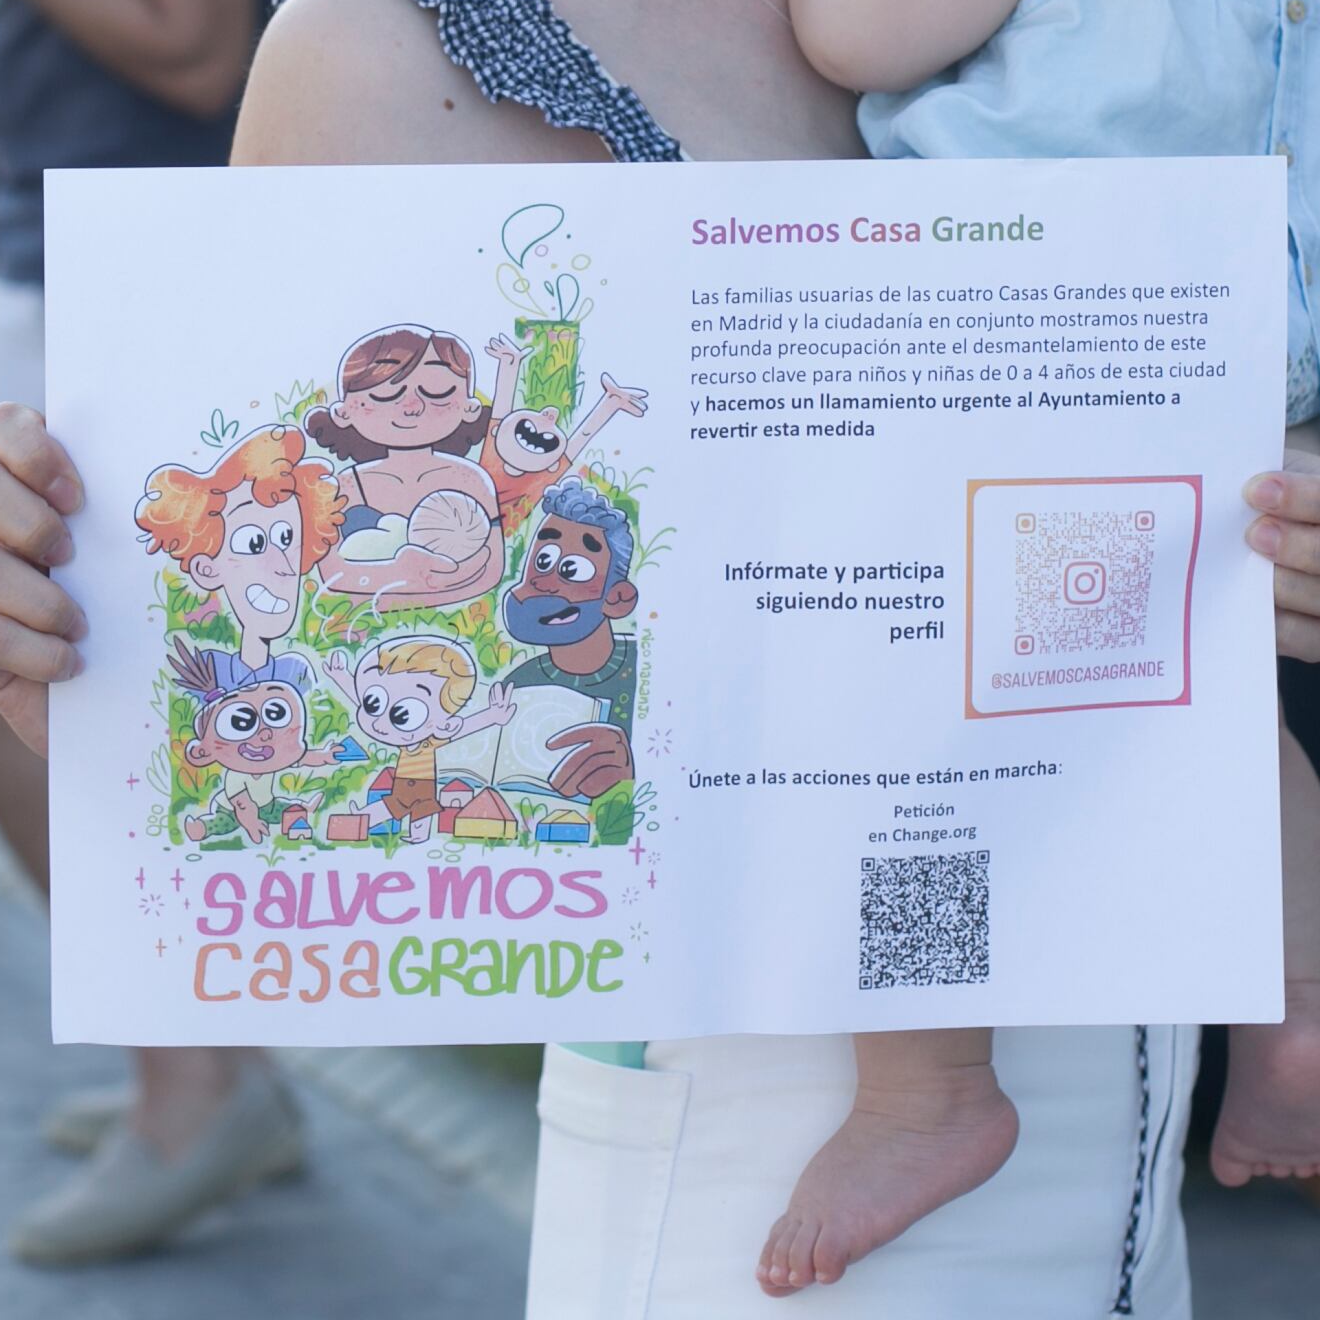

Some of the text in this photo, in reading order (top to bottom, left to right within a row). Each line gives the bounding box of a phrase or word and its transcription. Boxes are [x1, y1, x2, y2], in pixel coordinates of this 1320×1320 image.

[691, 213, 1044, 246] Salvemos Casa Grande
[691, 281, 1230, 305] Las familias usuarias de las cuatro Casas Grandes que existen
[690, 310, 1209, 334] en Madrid y la ciudadanía en conjunto mostramos nuestra
[690, 334, 1207, 362] profunda preocupación ante el desmantelamiento de este
[690, 359, 1226, 387] recurso clave para niños y niñas de 0 a 4 años de esta ciudad
[690, 389, 1181, 417] y hacemos un llamamiento urgente al Ayuntamiento a
[690, 419, 875, 440] revertir esta medida
[725, 560, 945, 585] Infórmate y participa
[755, 591, 945, 614] siguiendo nuestro
[889, 620, 945, 645] perfil
[991, 660, 1165, 689] @SALVEMOSCASAGRANDE
[688, 759, 1063, 790] Únete a las acciones que están en marcha:
[893, 802, 955, 819] Petición
[868, 826, 977, 844] en Change.org
